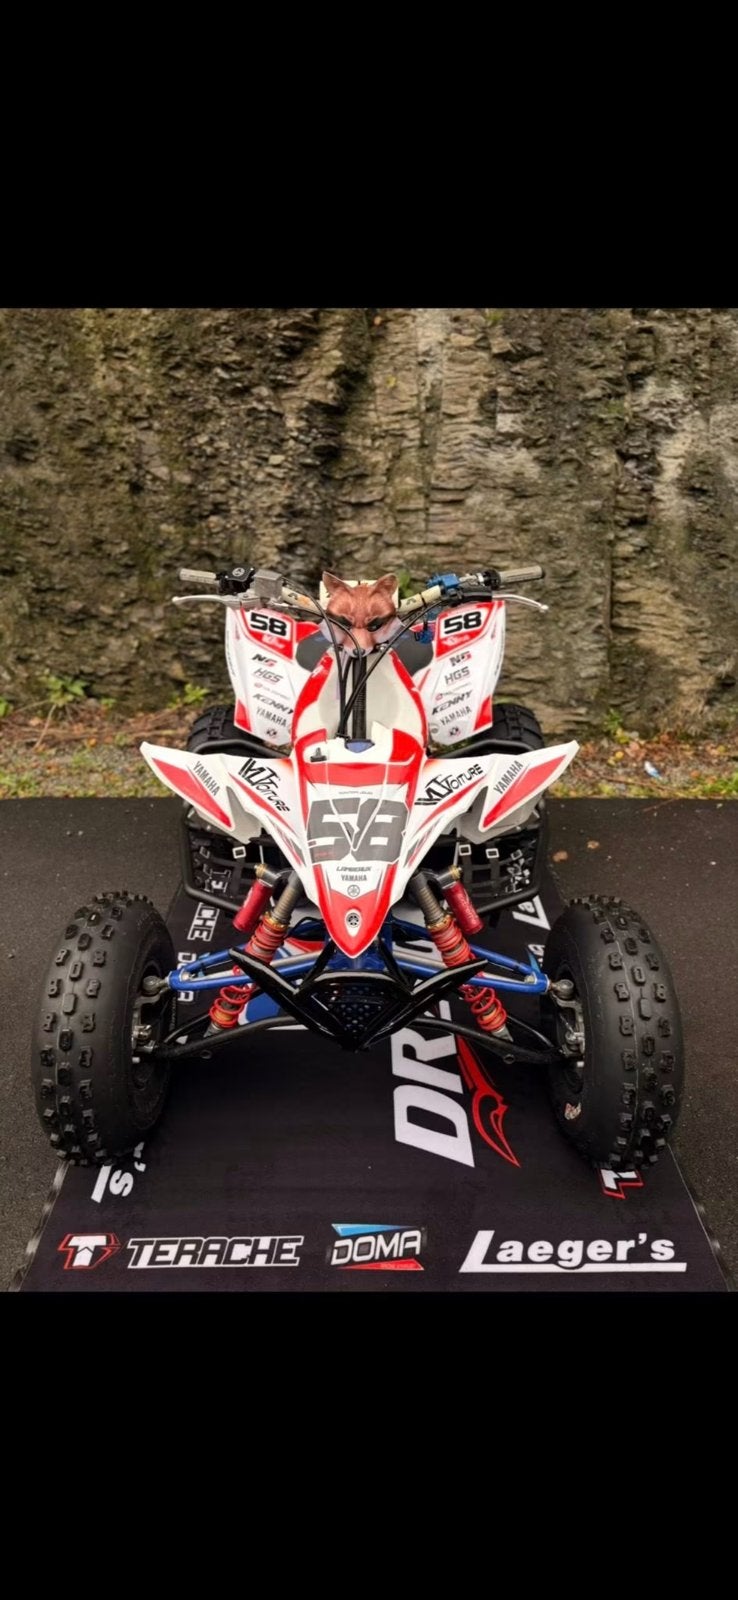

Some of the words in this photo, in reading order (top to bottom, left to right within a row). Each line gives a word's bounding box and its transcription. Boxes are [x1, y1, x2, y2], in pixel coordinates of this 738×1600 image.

[250, 612, 288, 637] 58
[444, 611, 483, 635] 58
[253, 668, 284, 684] HGS
[444, 666, 471, 685] HGS
[431, 690, 473, 716] KENNY
[255, 706, 288, 728] YAMAHA
[439, 705, 473, 727] YAMAHA
[192, 760, 221, 797] YAMAHA
[493, 760, 525, 795] YAMAHA
[306, 797, 410, 865] 58
[340, 874, 368, 882] YAMAHA
[126, 1235, 305, 1269] TERACHE
[330, 1229, 423, 1266] DOMA
[459, 1229, 688, 1274] Laeger's
